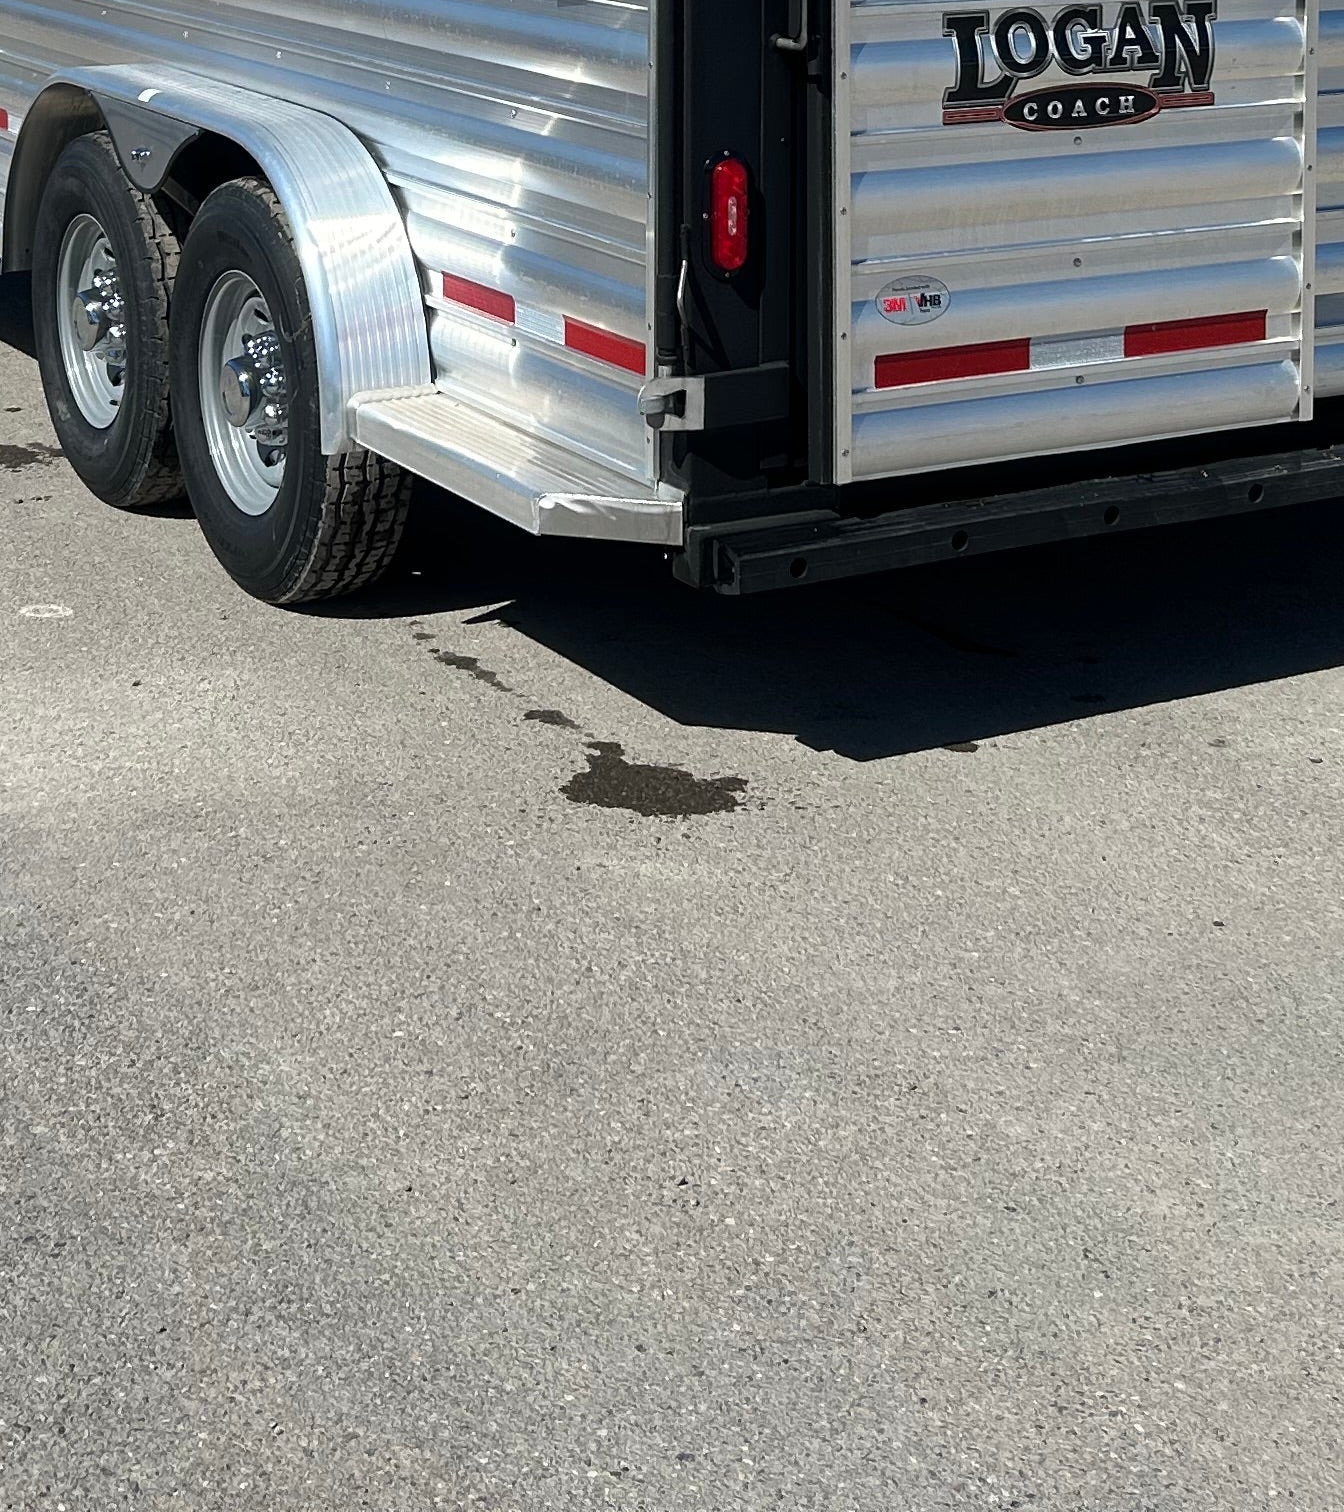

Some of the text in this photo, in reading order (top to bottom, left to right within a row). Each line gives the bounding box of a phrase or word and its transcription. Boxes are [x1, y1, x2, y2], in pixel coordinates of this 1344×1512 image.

[1022, 95, 1136, 121] COACH
[882, 292, 943, 314] 3M VHB
